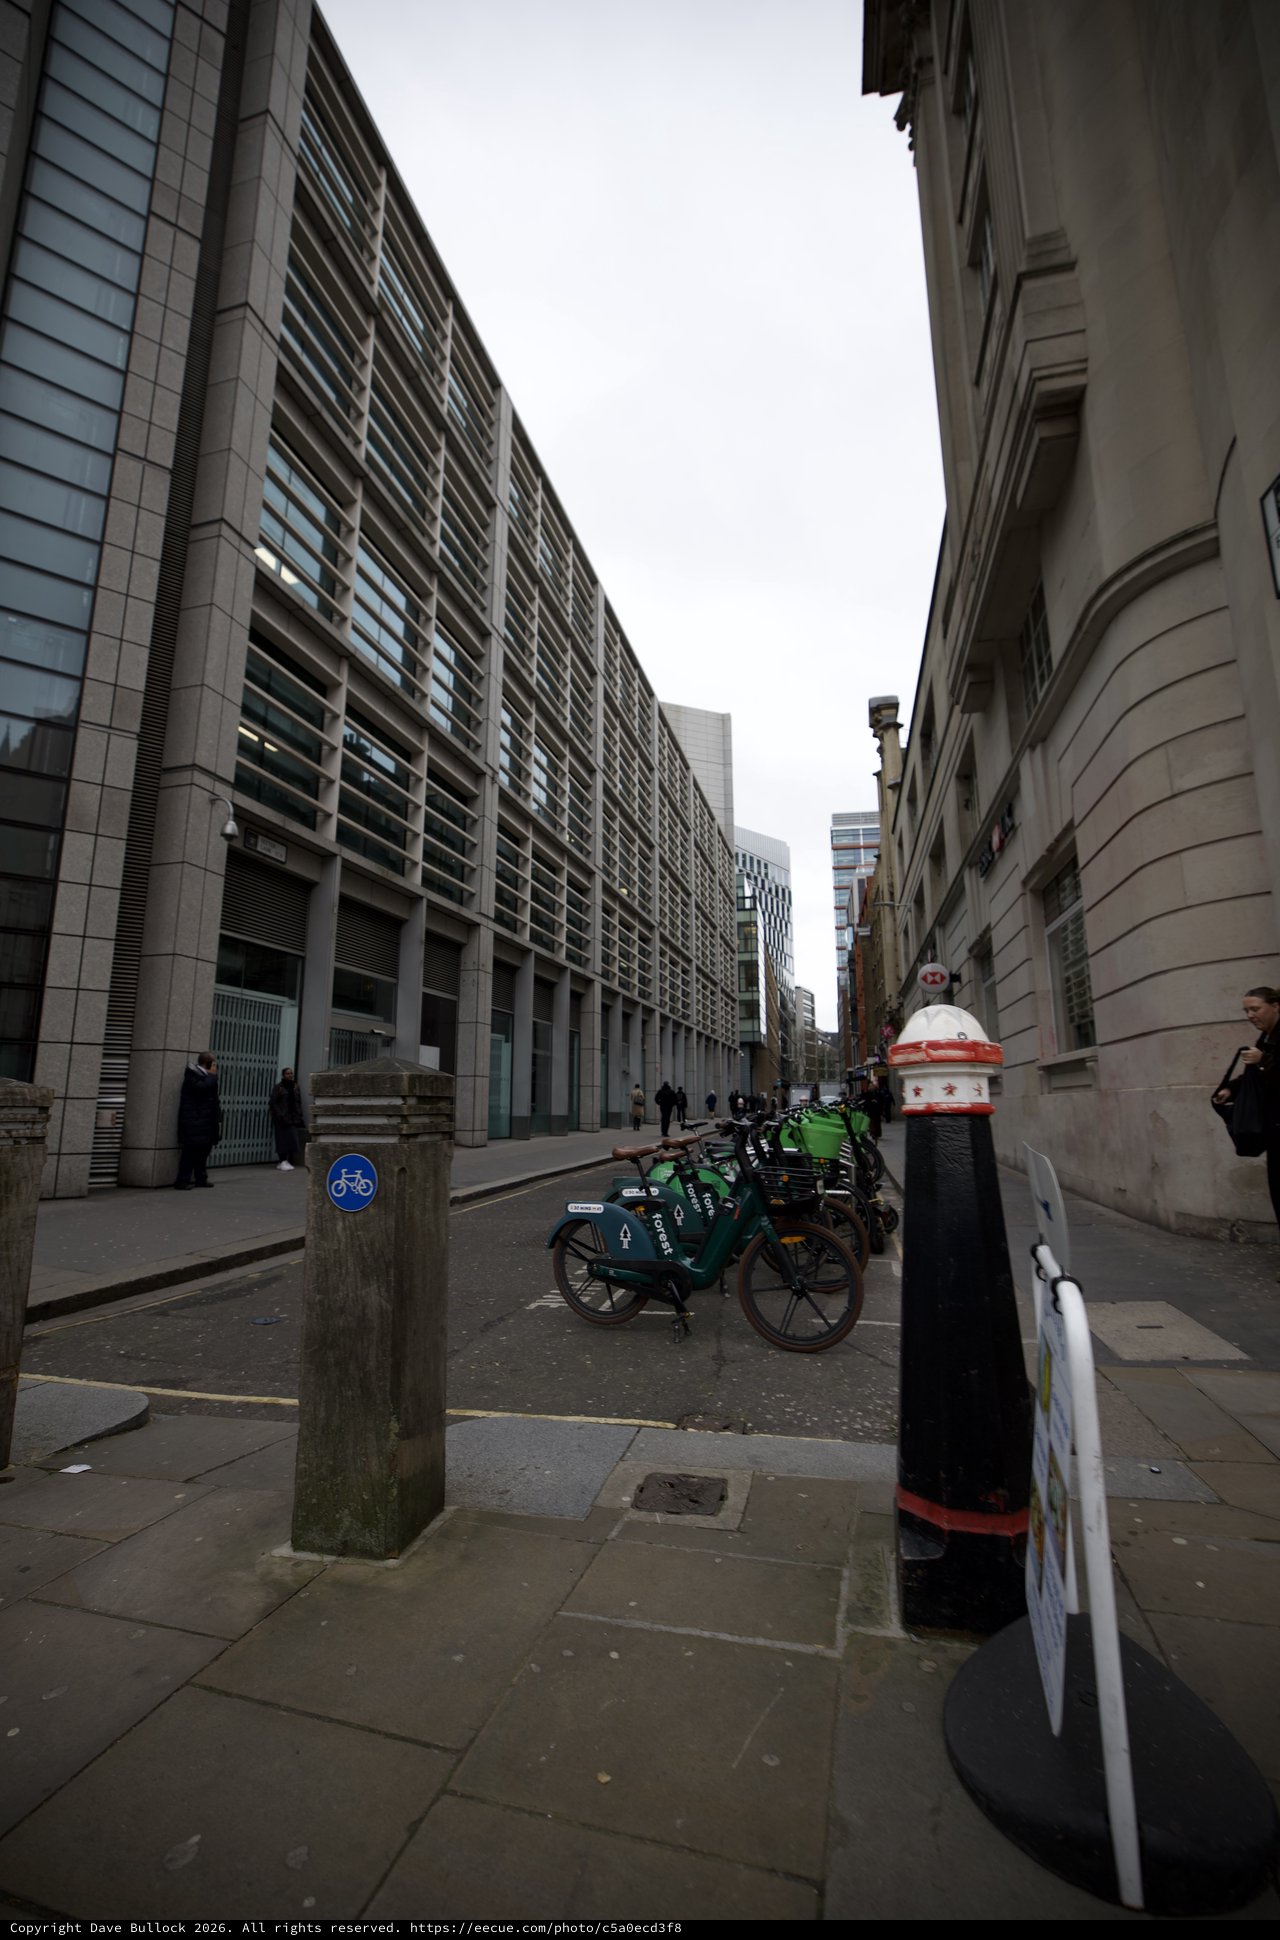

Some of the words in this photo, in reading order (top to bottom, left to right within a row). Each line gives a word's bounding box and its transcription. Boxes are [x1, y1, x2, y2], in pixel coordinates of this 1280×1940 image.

[685, 1183, 702, 1213] forest
[702, 1192, 716, 1220] fore
[651, 1212, 674, 1256] forest
